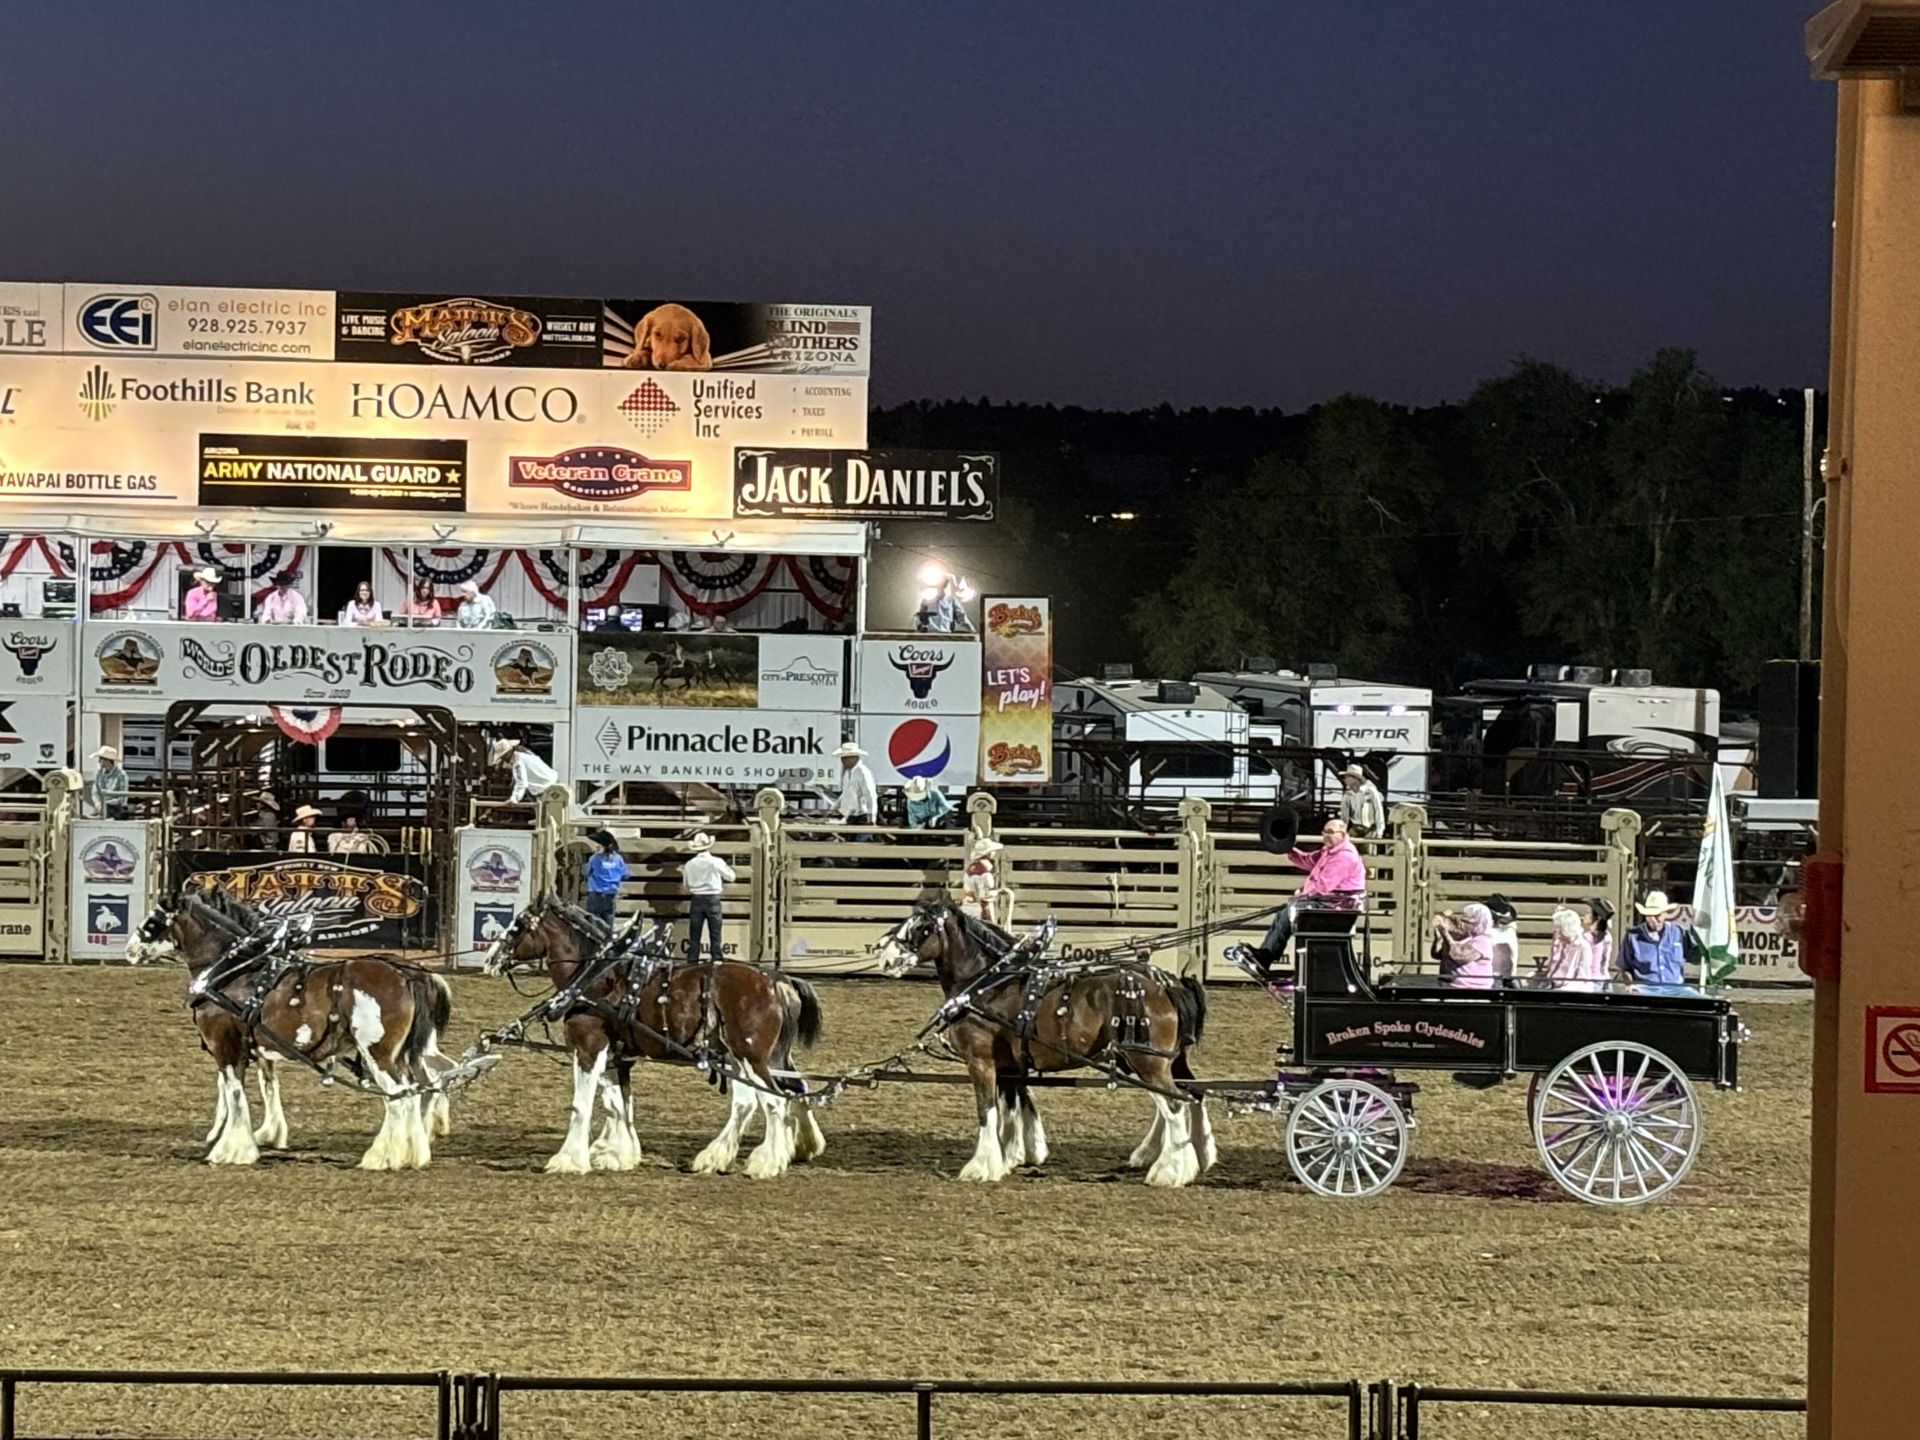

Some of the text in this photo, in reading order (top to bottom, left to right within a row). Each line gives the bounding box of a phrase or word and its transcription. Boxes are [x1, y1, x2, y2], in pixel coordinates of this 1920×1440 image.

[168, 299, 210, 313] elan
[218, 300, 290, 315] electric
[794, 307, 858, 318] ORIGINALS
[188, 317, 307, 336] 928.925.7937
[341, 314, 387, 326] LIVE MUSIC
[546, 321, 596, 333] WHISKEY ROW
[351, 326, 385, 337] DANCING
[121, 377, 315, 405] Foothills Bank
[693, 379, 756, 400] Unified
[804, 387, 852, 397] ACCOUNTING
[351, 382, 578, 423] HOAMCO
[694, 399, 763, 419] Services
[803, 407, 826, 417] TAXES
[696, 418, 721, 438] Inc
[801, 428, 834, 438] PAYROLL
[203, 461, 441, 484] ARMY NATIONAL GUARD
[518, 461, 683, 483] Veteran Crane
[741, 456, 986, 507] JACK DANIEL'S
[66, 473, 122, 490] BOTTLE
[127, 475, 157, 491] GAS
[9, 631, 49, 646] Coors
[898, 644, 944, 662] Coors
[239, 642, 361, 684] OLDEST
[360, 641, 475, 693] RODEO
[986, 667, 1031, 686] LET'S
[904, 698, 938, 710] RODEO
[998, 680, 1046, 713] play!
[627, 725, 824, 755] Pinnacle Bank
[1332, 727, 1411, 746] RAPTOR
[583, 764, 611, 775] THE
[620, 765, 652, 777] WAY
[660, 766, 735, 777] BANKING
[743, 767, 809, 779] SHOULD
[1325, 1020, 1485, 1049] Broken Spoke Clydesdales
